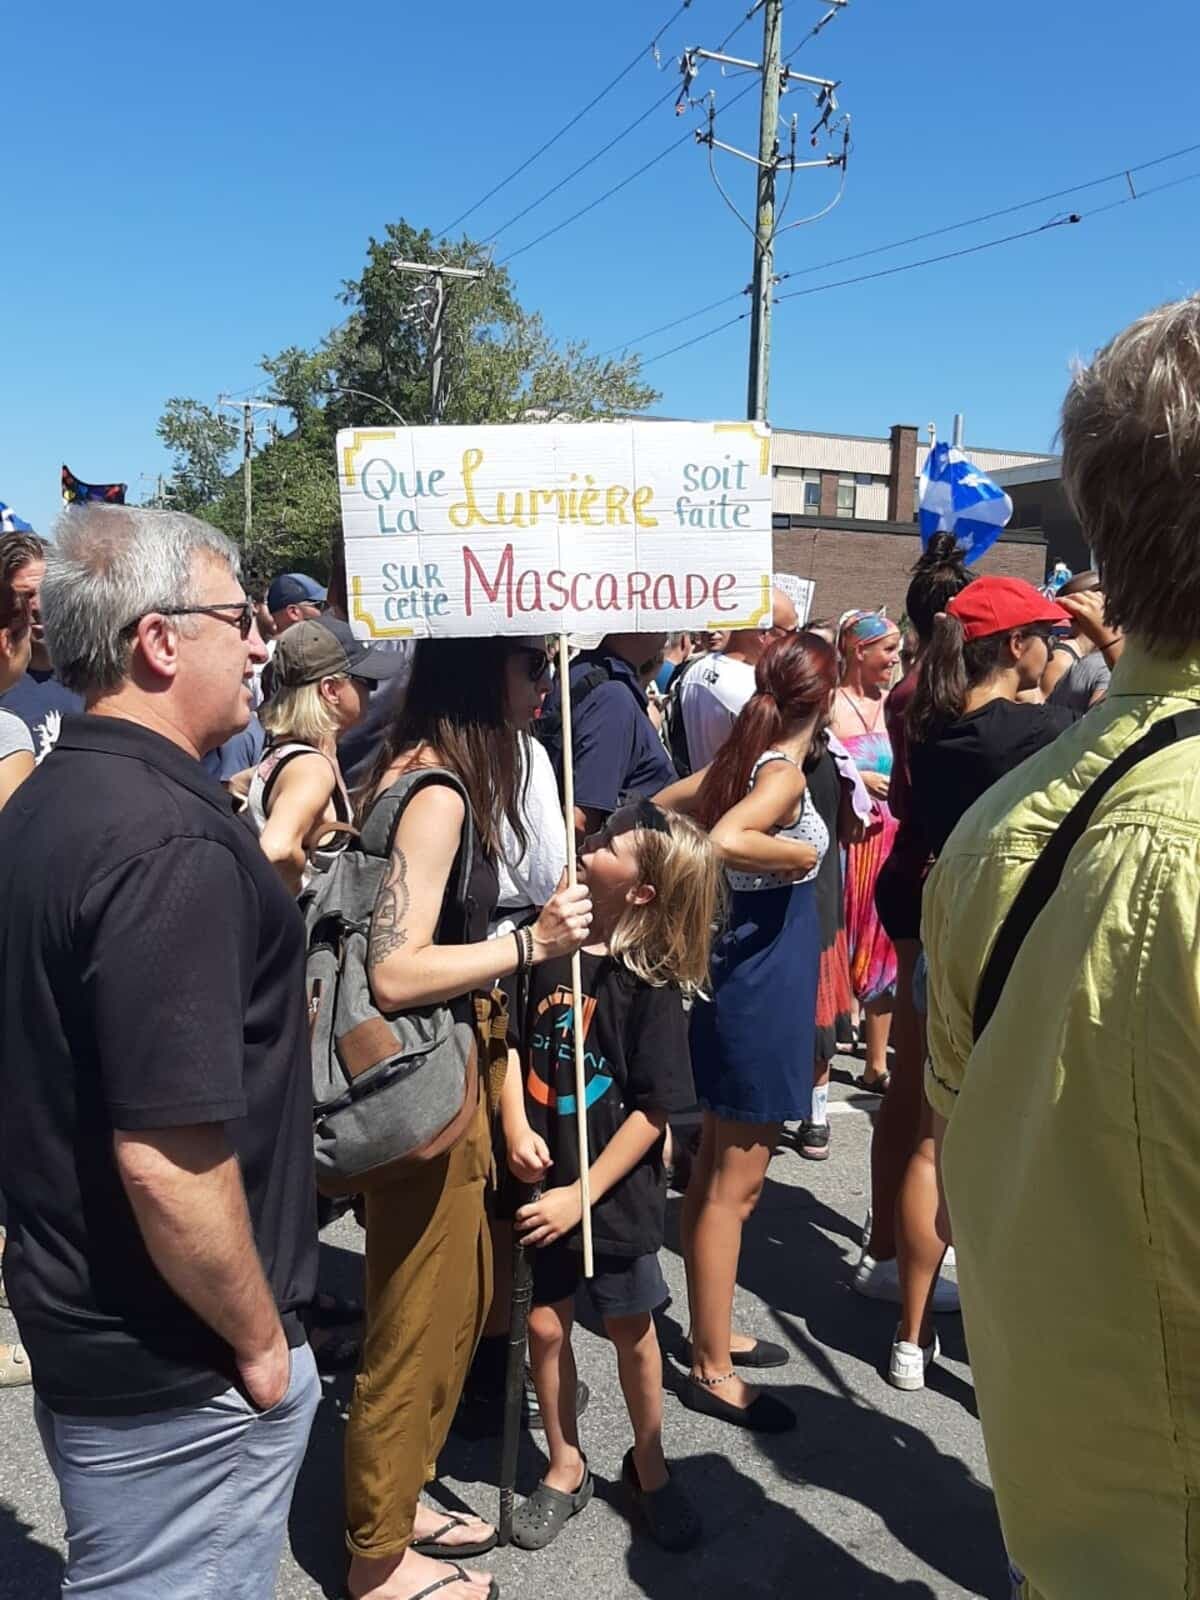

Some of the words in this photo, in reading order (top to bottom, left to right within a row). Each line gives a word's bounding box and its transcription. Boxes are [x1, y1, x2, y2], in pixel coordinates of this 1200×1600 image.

[361, 458, 448, 501] Que
[378, 503, 424, 533] La
[674, 494, 752, 529] faite
[384, 590, 451, 622] cette
